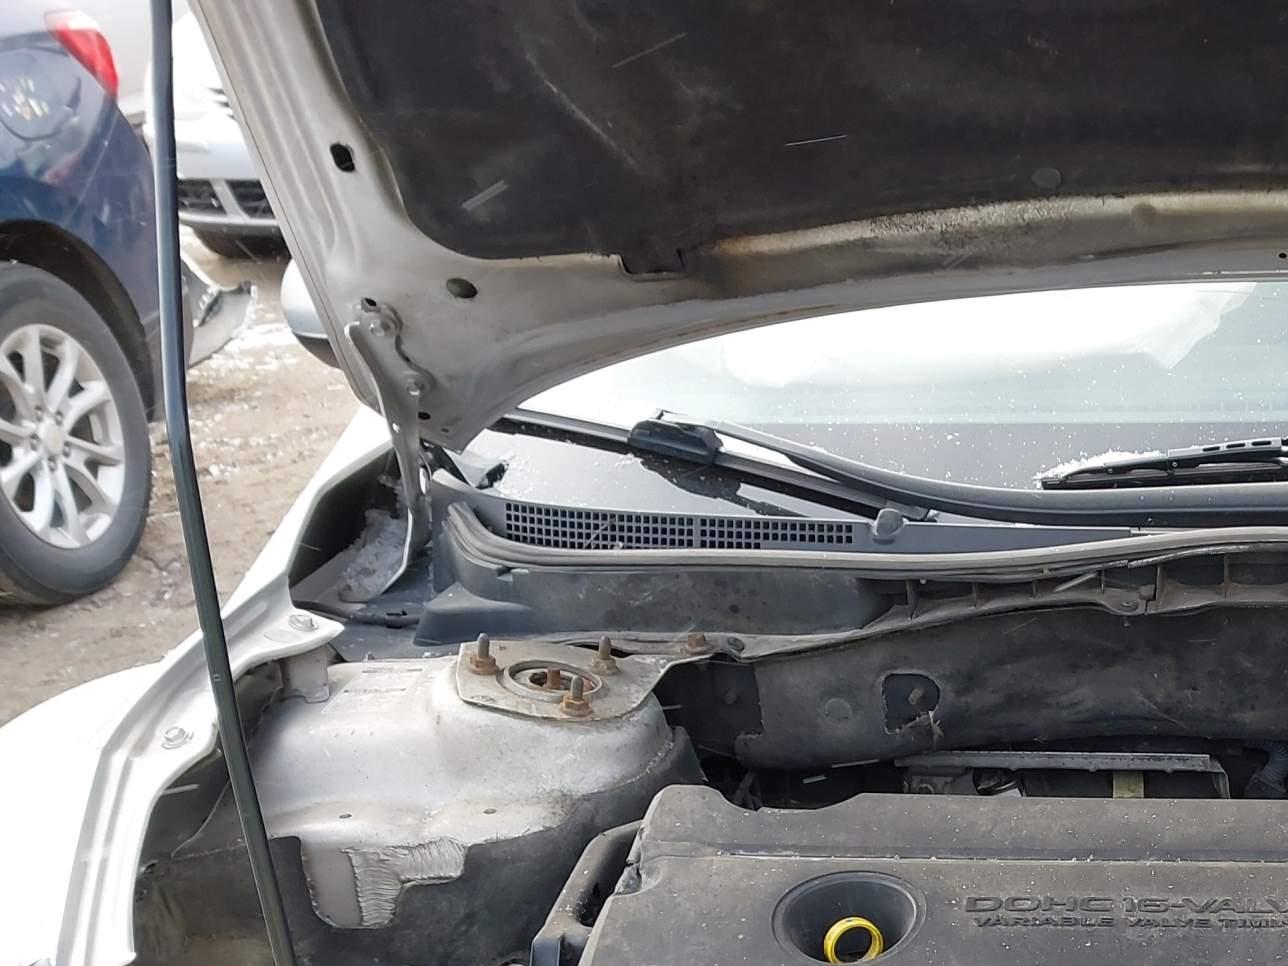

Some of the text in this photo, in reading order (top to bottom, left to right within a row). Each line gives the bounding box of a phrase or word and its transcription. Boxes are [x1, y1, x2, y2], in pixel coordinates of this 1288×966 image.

[965, 896, 1115, 913] DOHC
[973, 916, 1115, 928] VARIABLE
[1128, 917, 1213, 929] VALVE
